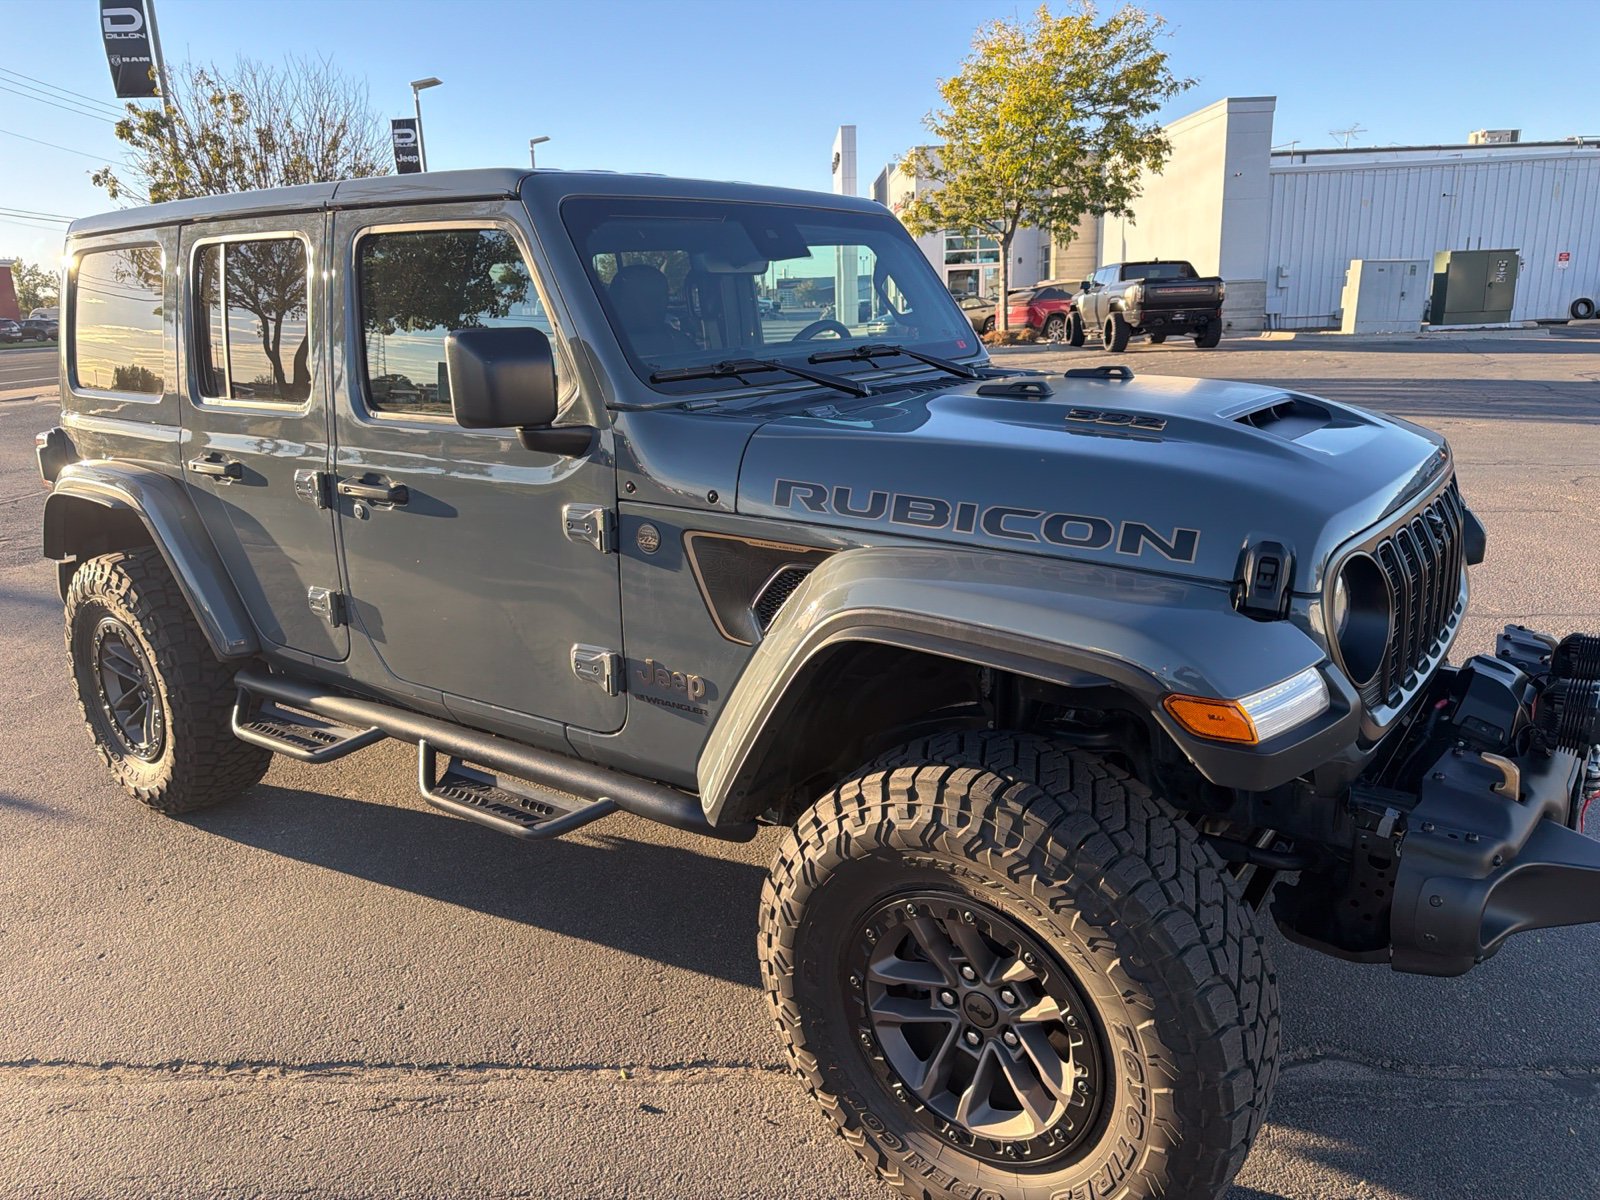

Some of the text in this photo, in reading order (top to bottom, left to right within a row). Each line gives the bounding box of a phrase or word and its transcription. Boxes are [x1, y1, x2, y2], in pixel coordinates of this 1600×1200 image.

[396, 154, 419, 163] Jeep
[1065, 408, 1168, 431] 392
[774, 478, 1201, 563] RUBICON
[636, 658, 706, 702] Jeep
[645, 694, 709, 716] WRANGLER
[1110, 1022, 1147, 1141] TOYO
